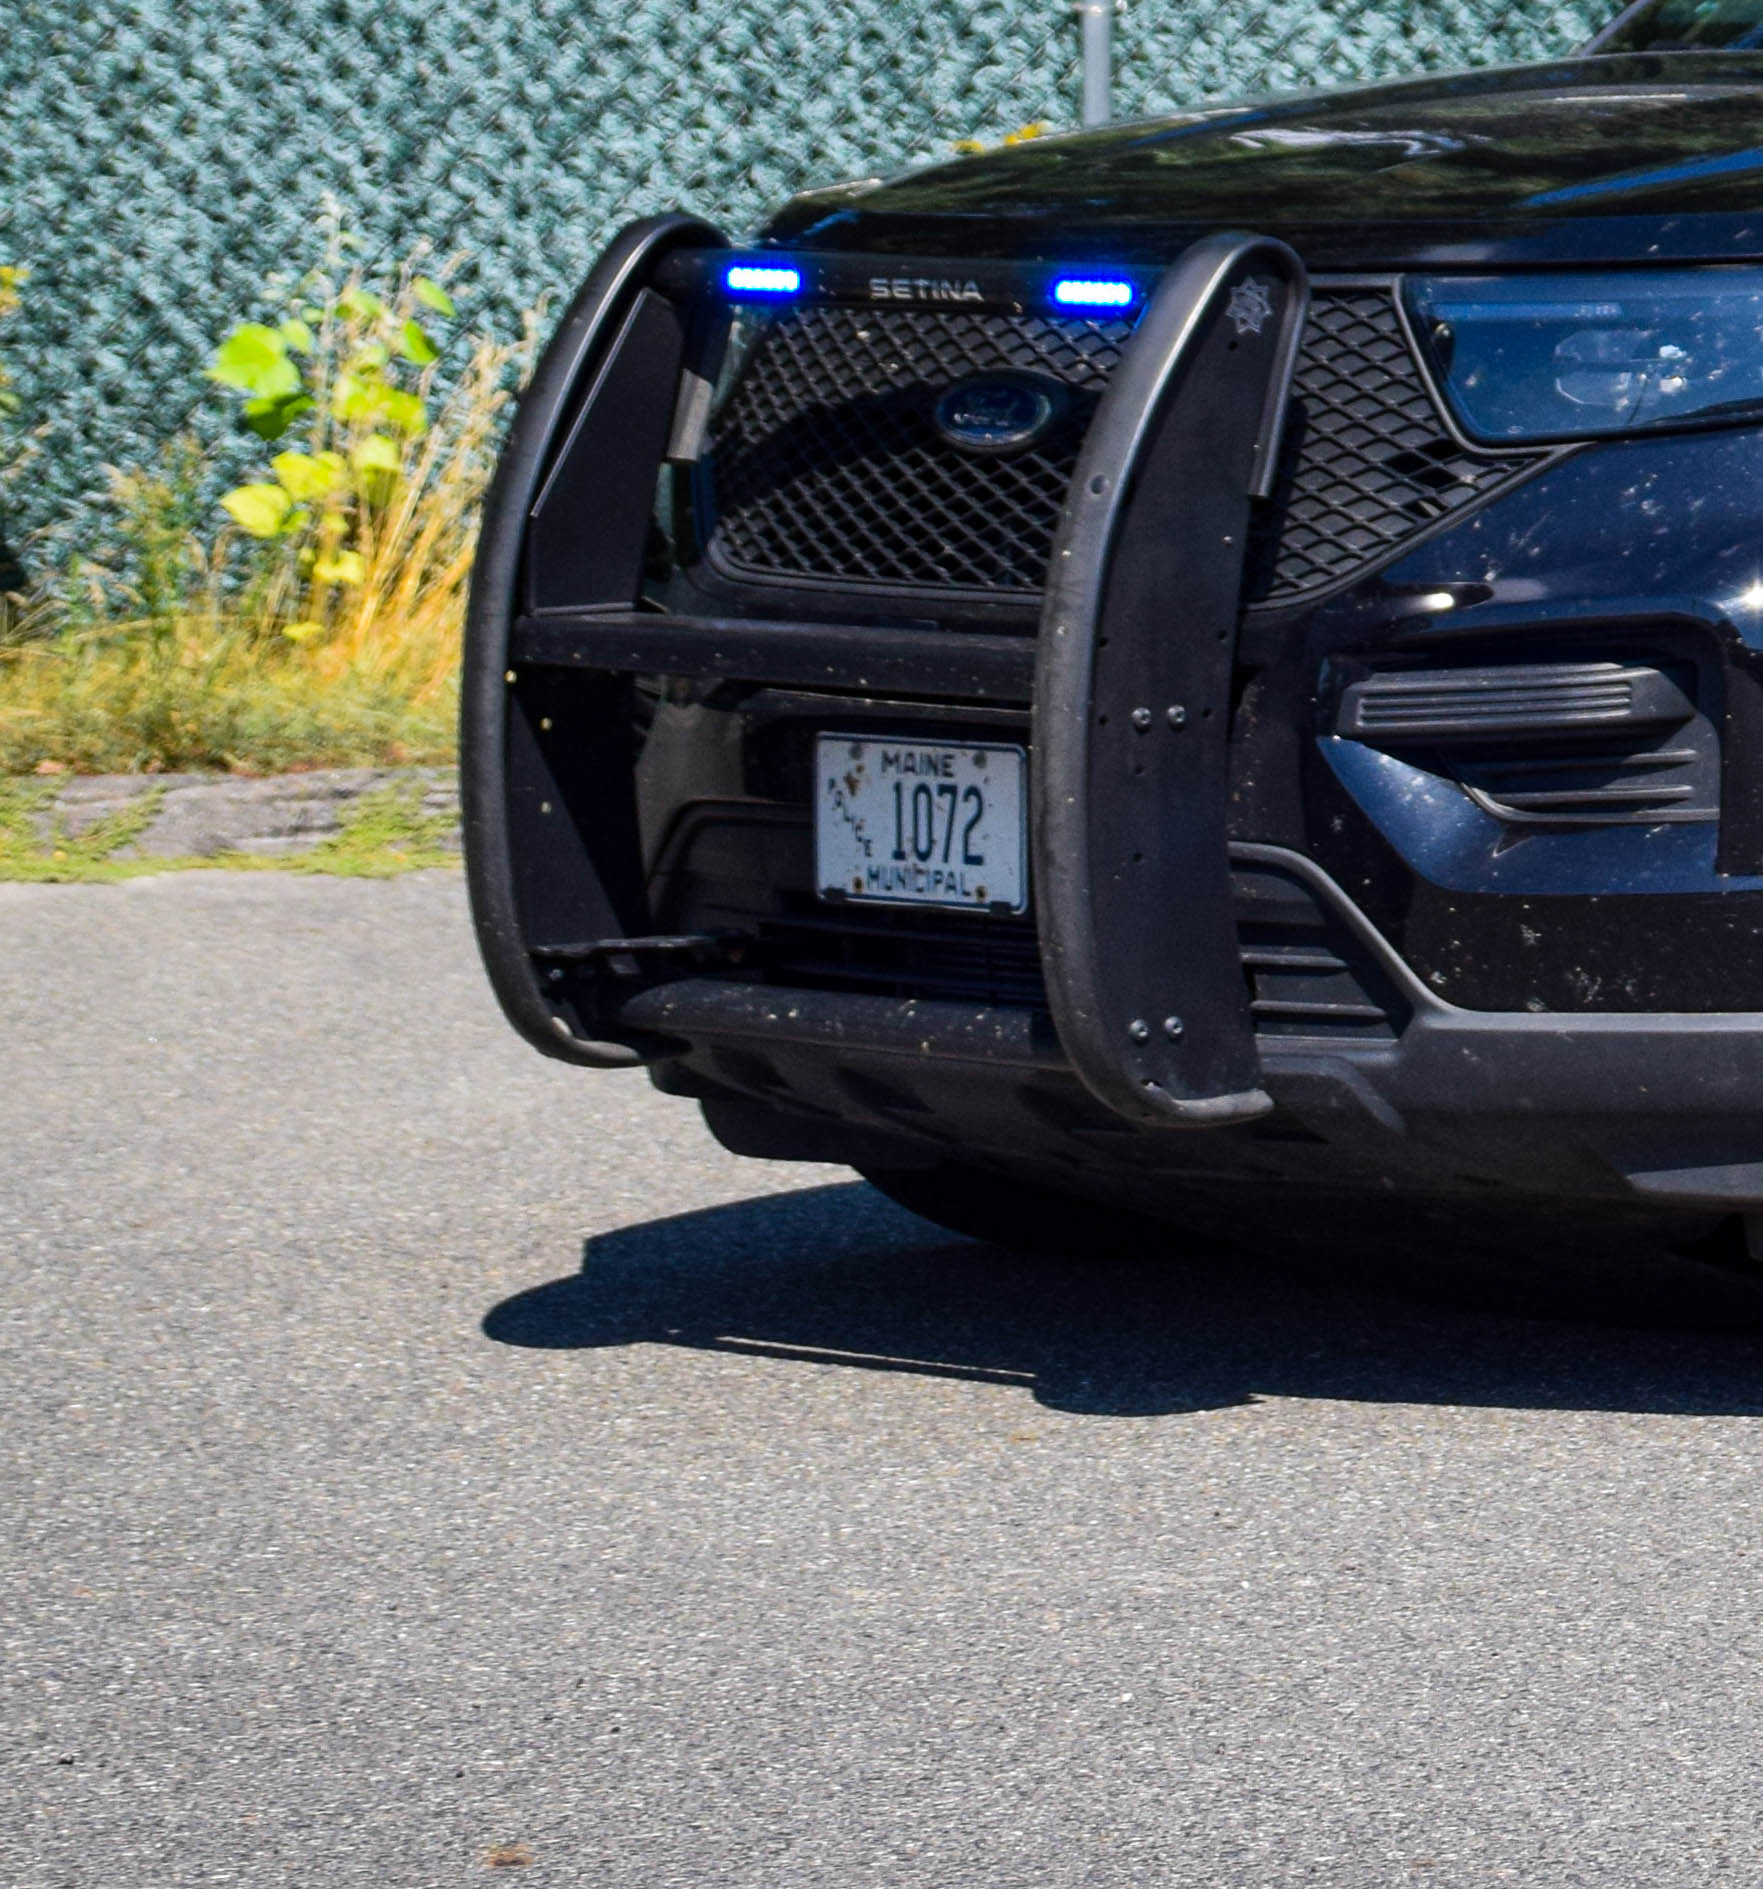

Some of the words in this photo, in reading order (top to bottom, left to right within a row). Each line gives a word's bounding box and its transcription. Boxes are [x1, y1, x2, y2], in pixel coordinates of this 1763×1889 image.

[869, 277, 985, 303] SETINA
[880, 750, 956, 778] MAINE
[827, 777, 873, 858] POLICE
[891, 781, 984, 866] 1072
[866, 865, 973, 897] MUNICIPAL
